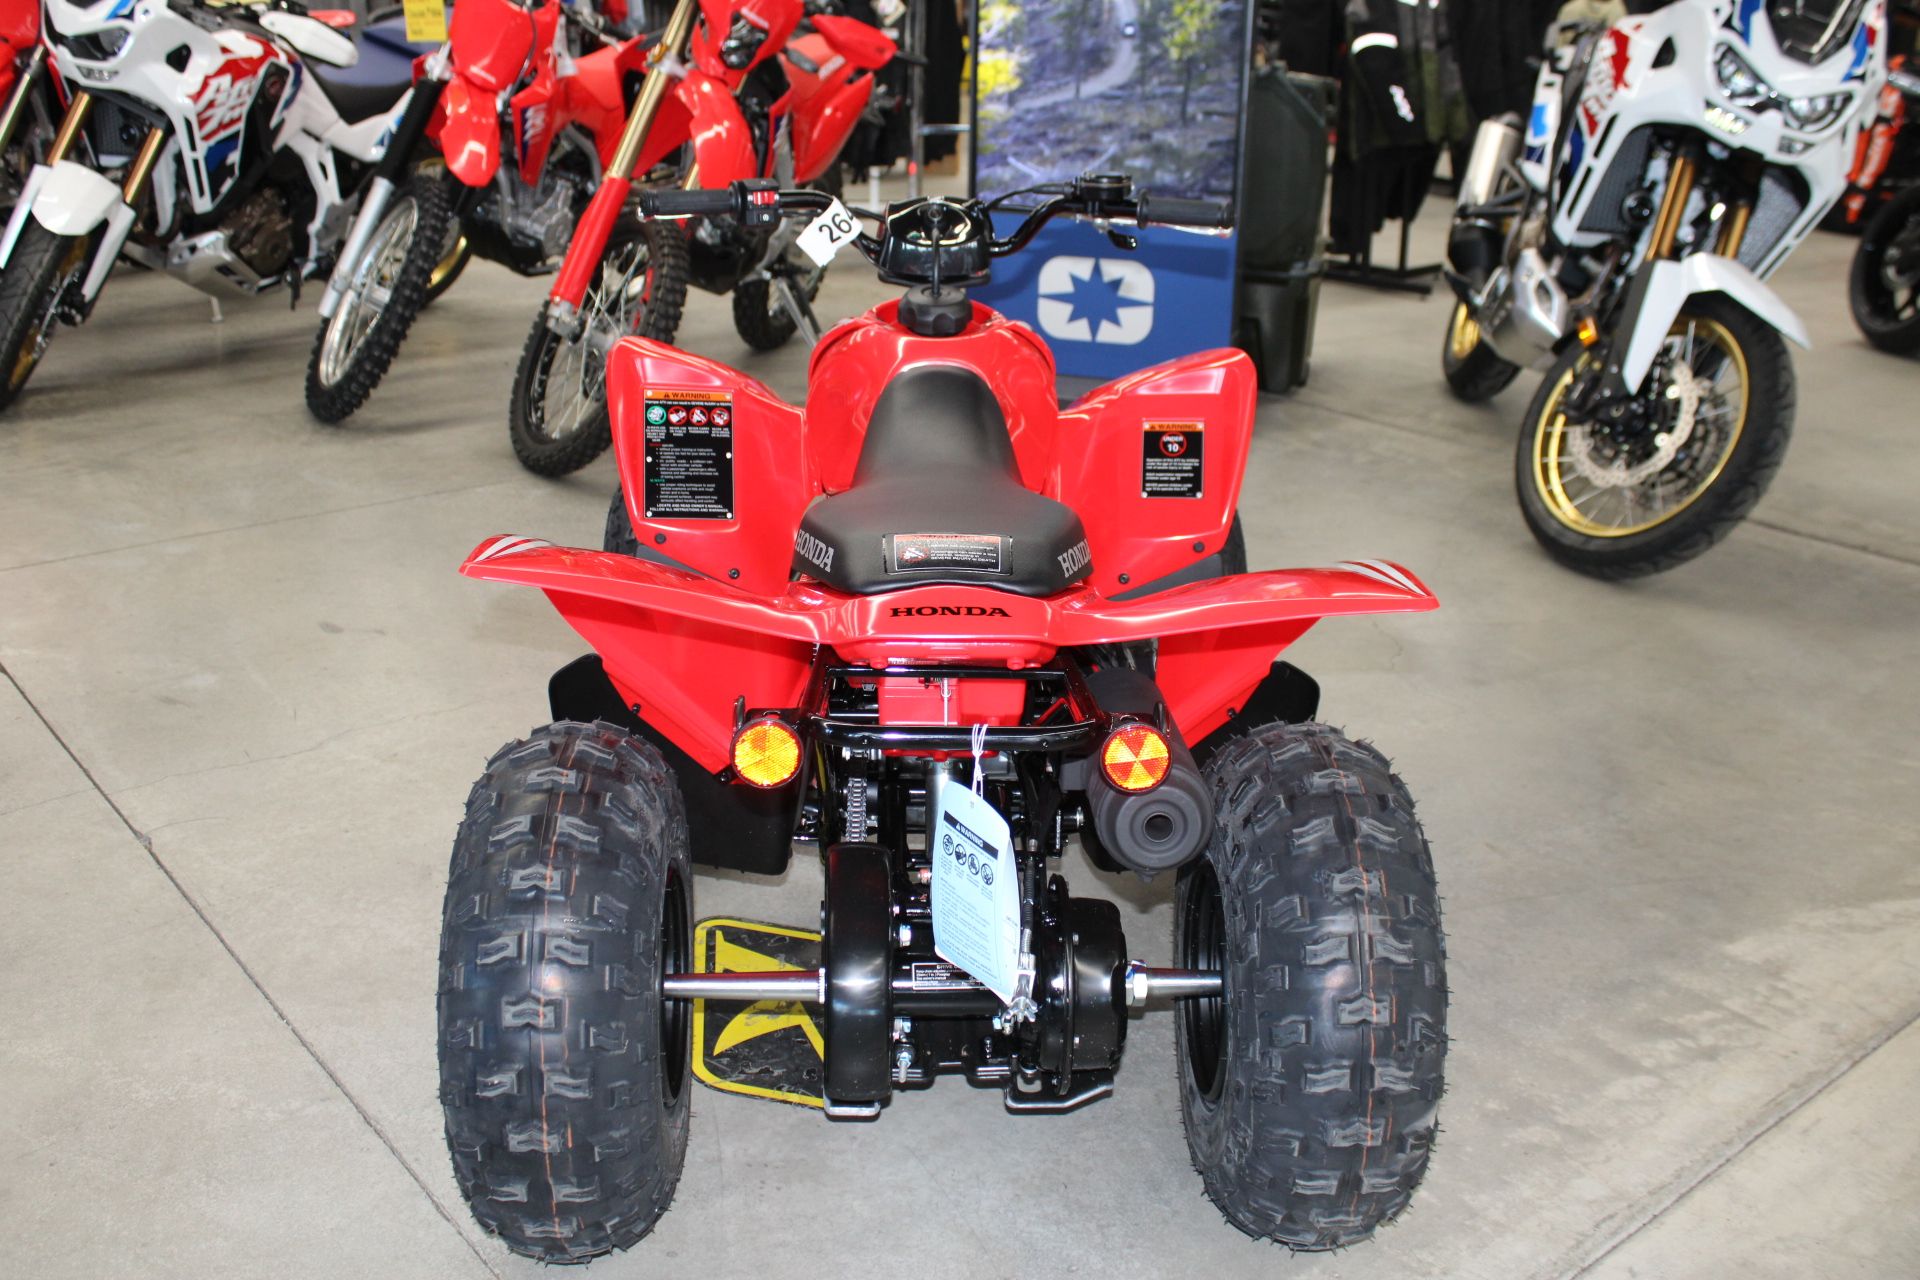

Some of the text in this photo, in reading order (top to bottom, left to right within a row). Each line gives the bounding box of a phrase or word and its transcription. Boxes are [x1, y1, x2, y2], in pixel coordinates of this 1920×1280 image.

[1167, 443, 1179, 452] 10
[795, 529, 834, 573] HONDA
[889, 606, 1013, 618] HONDA
[959, 824, 985, 848] WARNING
